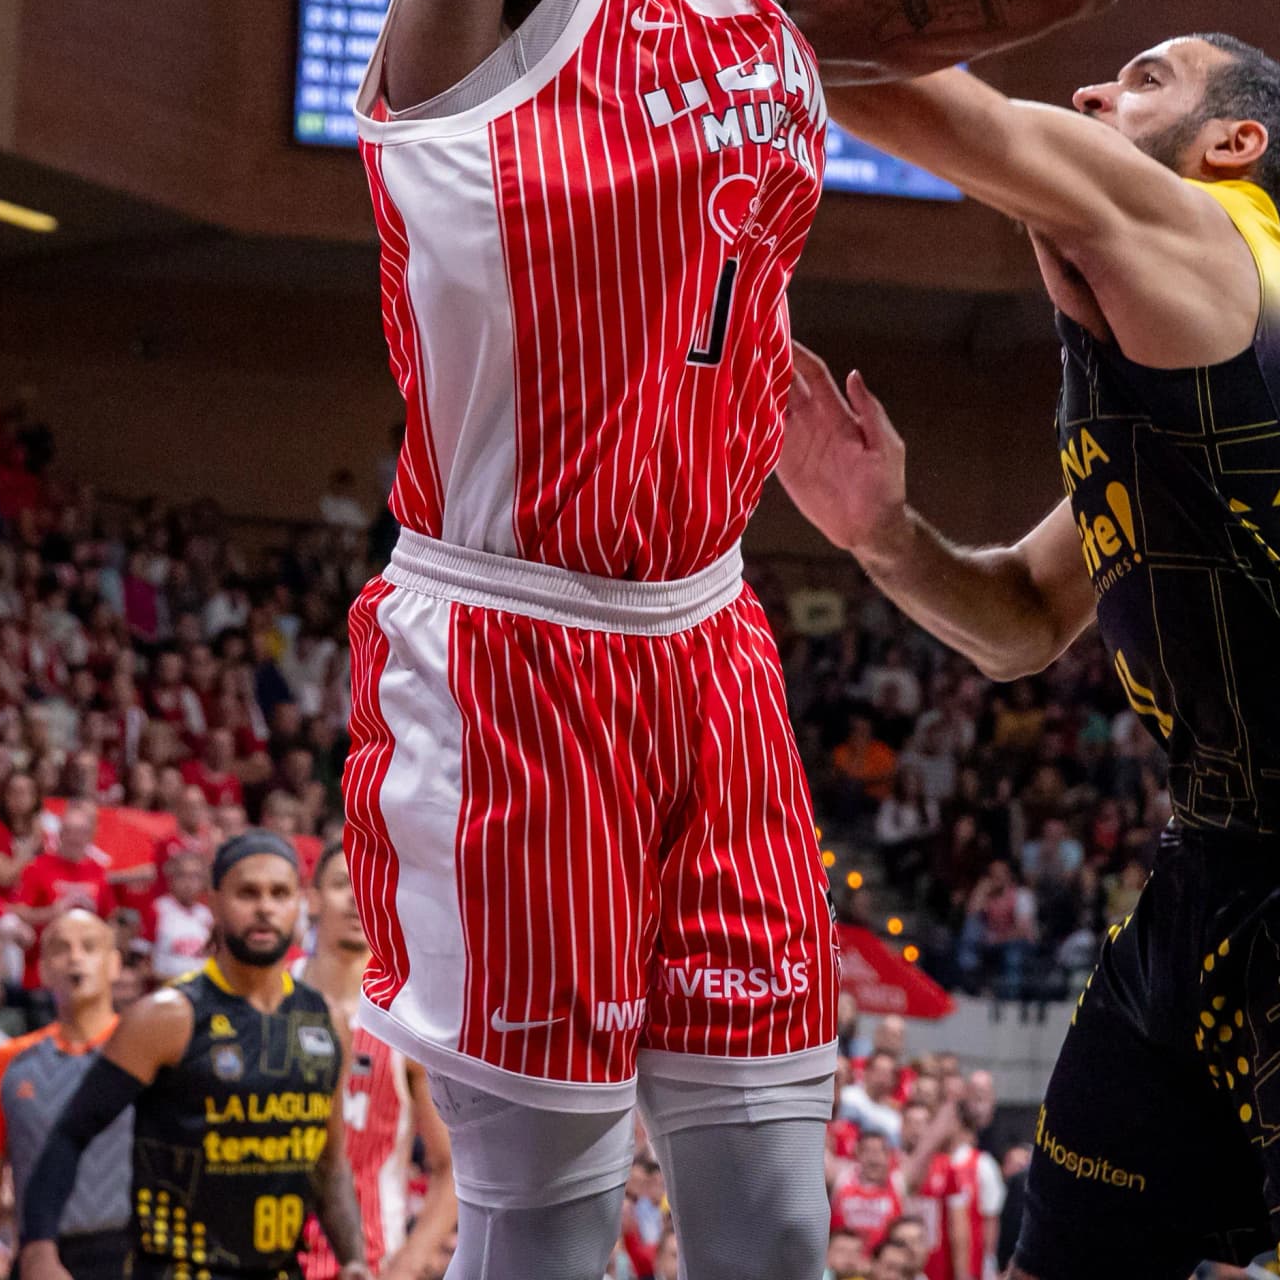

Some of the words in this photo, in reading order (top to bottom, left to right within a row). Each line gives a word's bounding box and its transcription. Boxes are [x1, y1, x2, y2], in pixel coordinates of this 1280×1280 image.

[205, 1094, 245, 1123] LA
[1042, 1130, 1146, 1193] Hospiten
[253, 1194, 303, 1254] 88
